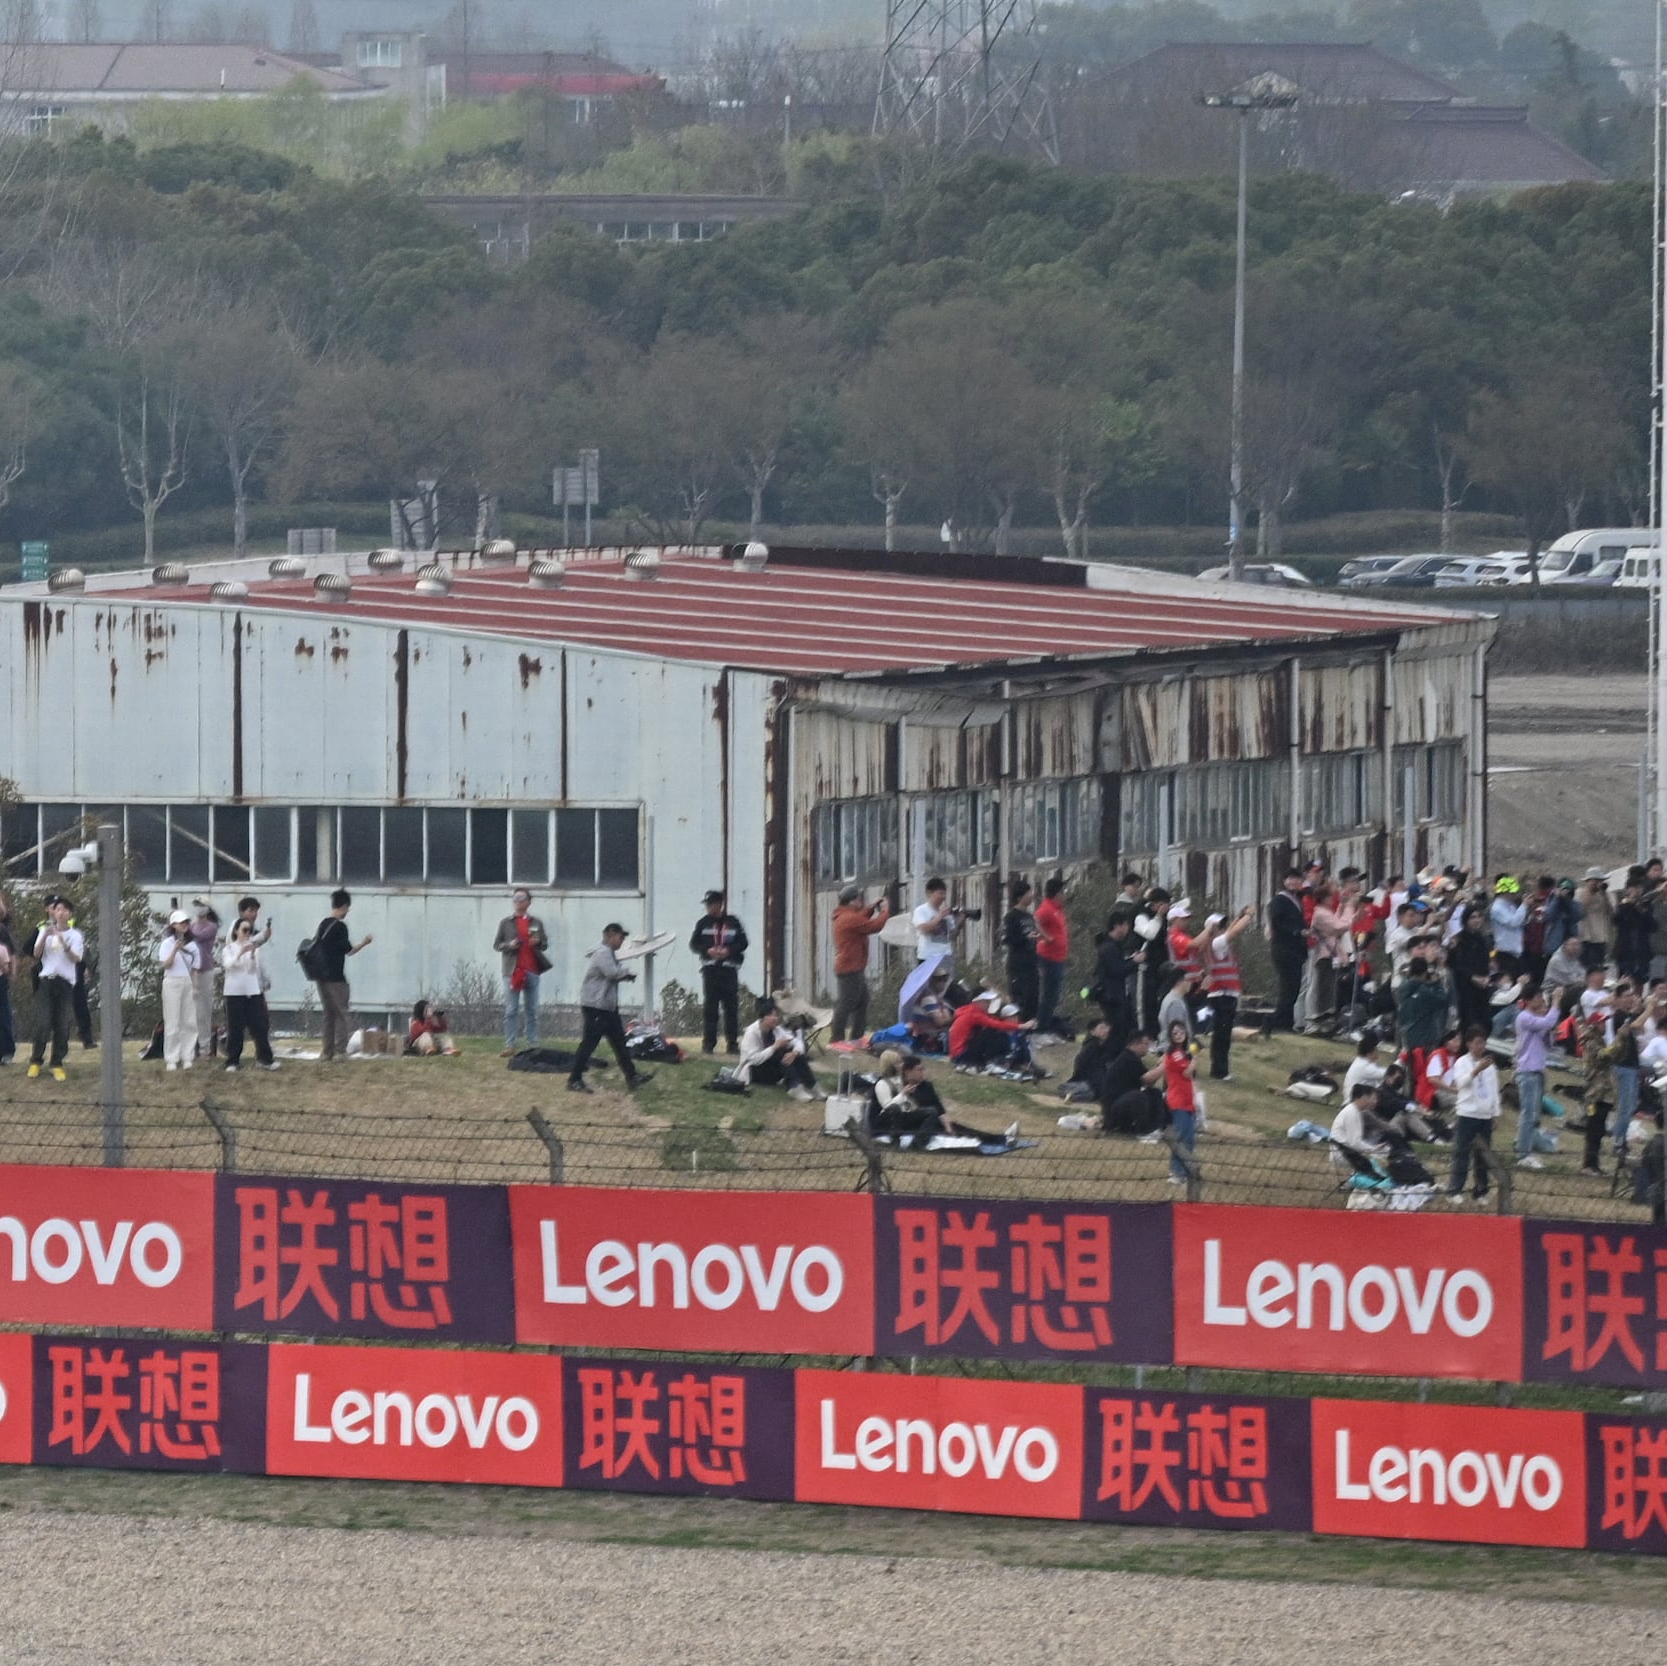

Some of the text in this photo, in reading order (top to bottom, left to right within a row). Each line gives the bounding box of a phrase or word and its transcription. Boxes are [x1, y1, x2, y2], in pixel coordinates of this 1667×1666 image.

[235, 1188, 452, 1329] 联想
[540, 1220, 844, 1312] Lenovo
[895, 1209, 1113, 1350] 联想
[1204, 1239, 1494, 1337] Lenovo
[1543, 1234, 1667, 1371] 联
[49, 1346, 221, 1459] 联想
[294, 1373, 539, 1451] Lenovo
[578, 1368, 747, 1486] 联想
[821, 1399, 1059, 1482] Lenovo
[1097, 1398, 1268, 1518] 联想
[1336, 1429, 1562, 1510] Lenovo
